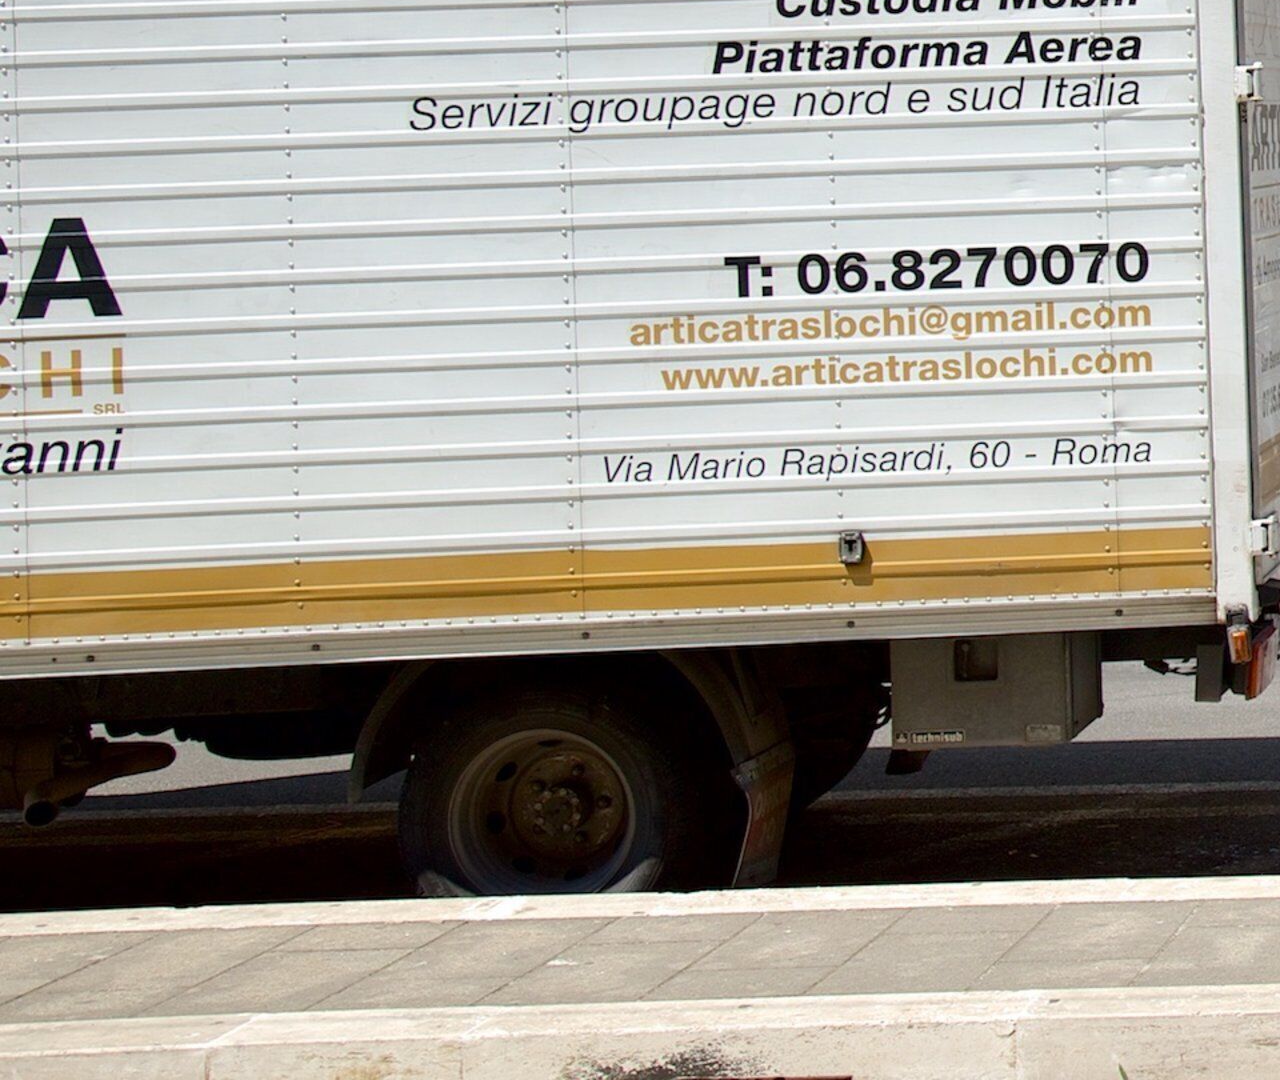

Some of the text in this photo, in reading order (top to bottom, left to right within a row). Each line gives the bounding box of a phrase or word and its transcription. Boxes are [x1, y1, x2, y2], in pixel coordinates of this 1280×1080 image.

[712, 31, 1141, 75] Piattaforma Aerea
[410, 73, 1140, 133] Servizi groupage nord e sud Italia
[0, 218, 123, 320] A
[725, 242, 1149, 298] T: 06.8270070
[629, 302, 1152, 347] articatraslochi@gmail.com
[660, 348, 1153, 391] www.articatraslochi.com
[93, 403, 126, 415] SRL
[0, 428, 123, 475] anni
[603, 453, 653, 484] Via
[667, 450, 766, 482] Mario
[780, 442, 953, 482] Rapisardi,
[969, 440, 1012, 470] 60
[1051, 437, 1152, 467] Roma
